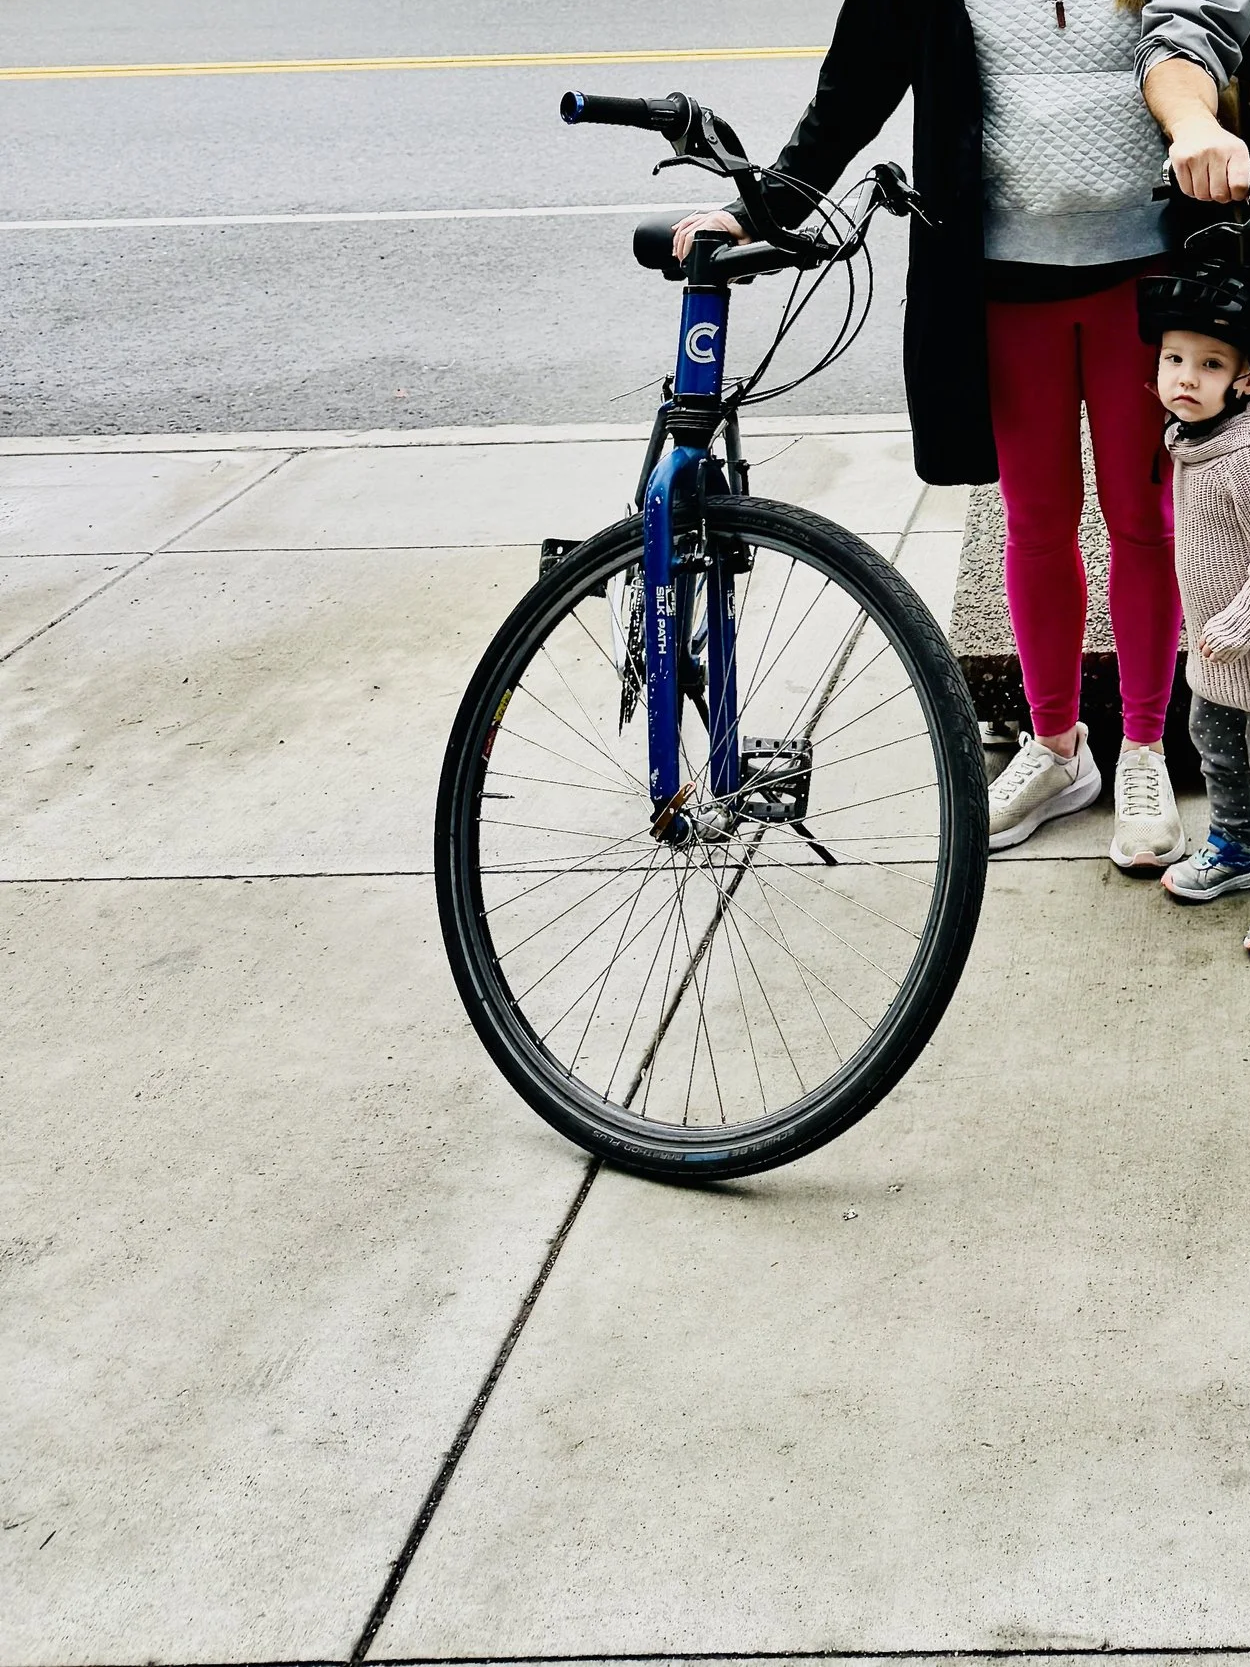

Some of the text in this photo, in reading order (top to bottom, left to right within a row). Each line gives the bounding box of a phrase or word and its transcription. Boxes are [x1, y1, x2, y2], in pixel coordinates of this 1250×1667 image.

[655, 586, 667, 655] SILK PATH
[592, 1130, 621, 1148] PLUS
[623, 1141, 685, 1163] MARATHON
[731, 1128, 796, 1159] SCHWALBE
